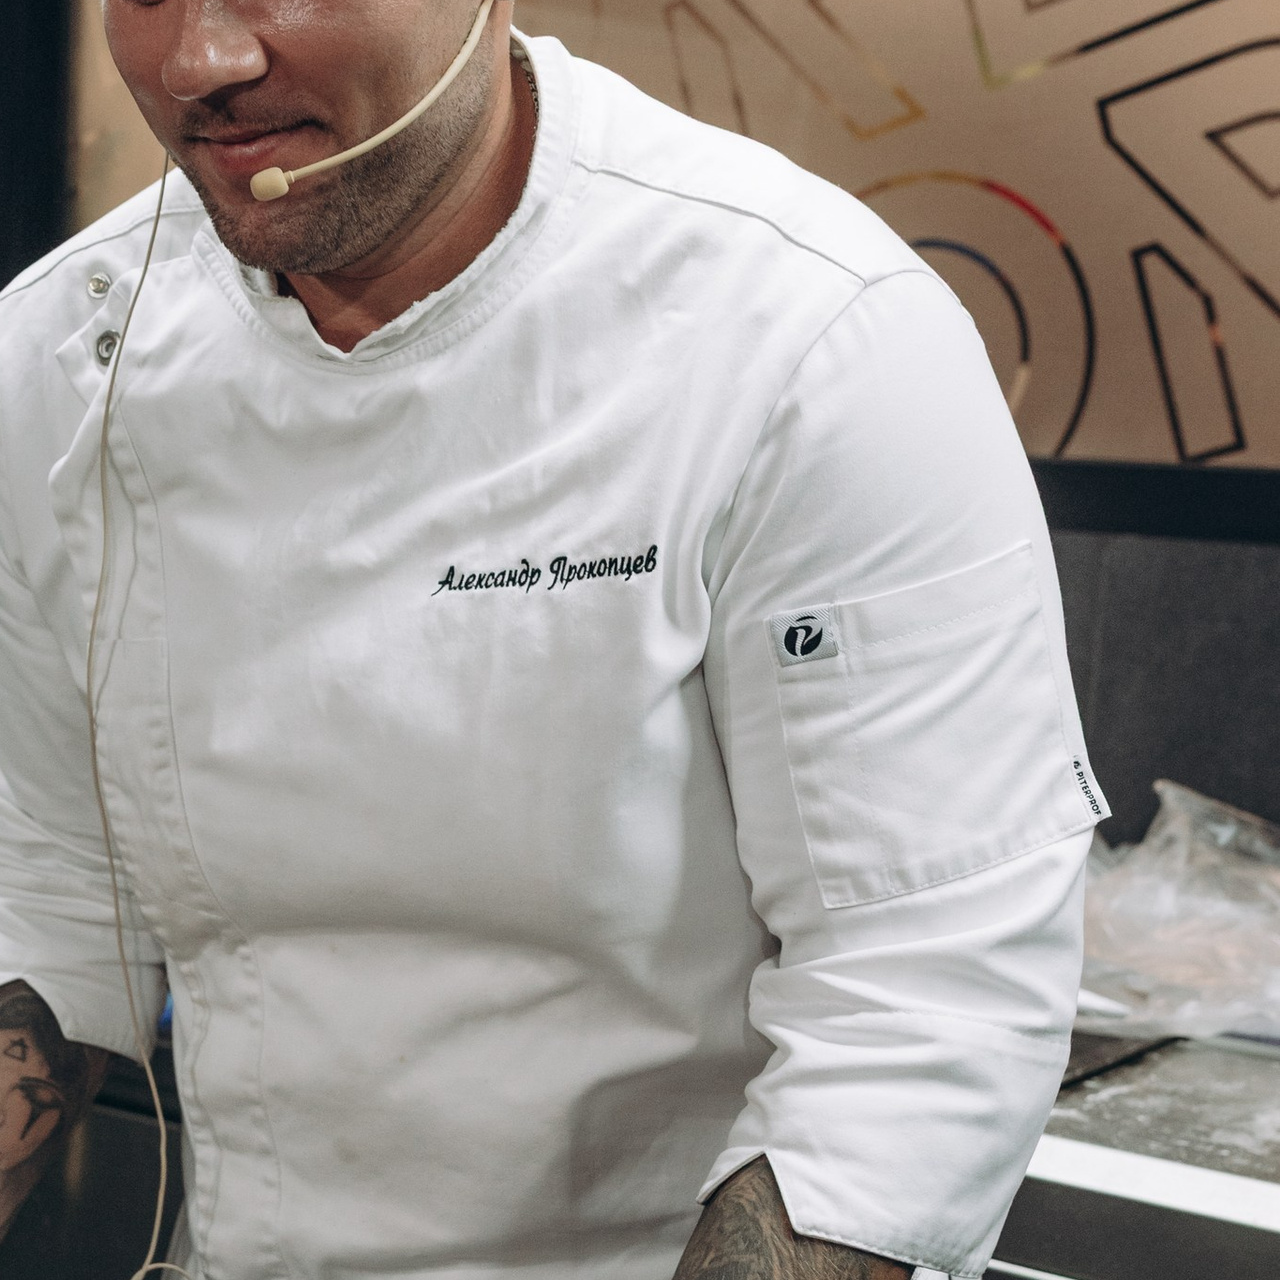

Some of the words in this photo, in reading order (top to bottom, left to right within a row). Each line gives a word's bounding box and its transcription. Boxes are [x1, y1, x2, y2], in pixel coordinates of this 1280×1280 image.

[431, 558, 542, 596] Александр
[548, 544, 658, 591] Прокопцев
[1076, 771, 1102, 816] PITERPROF
